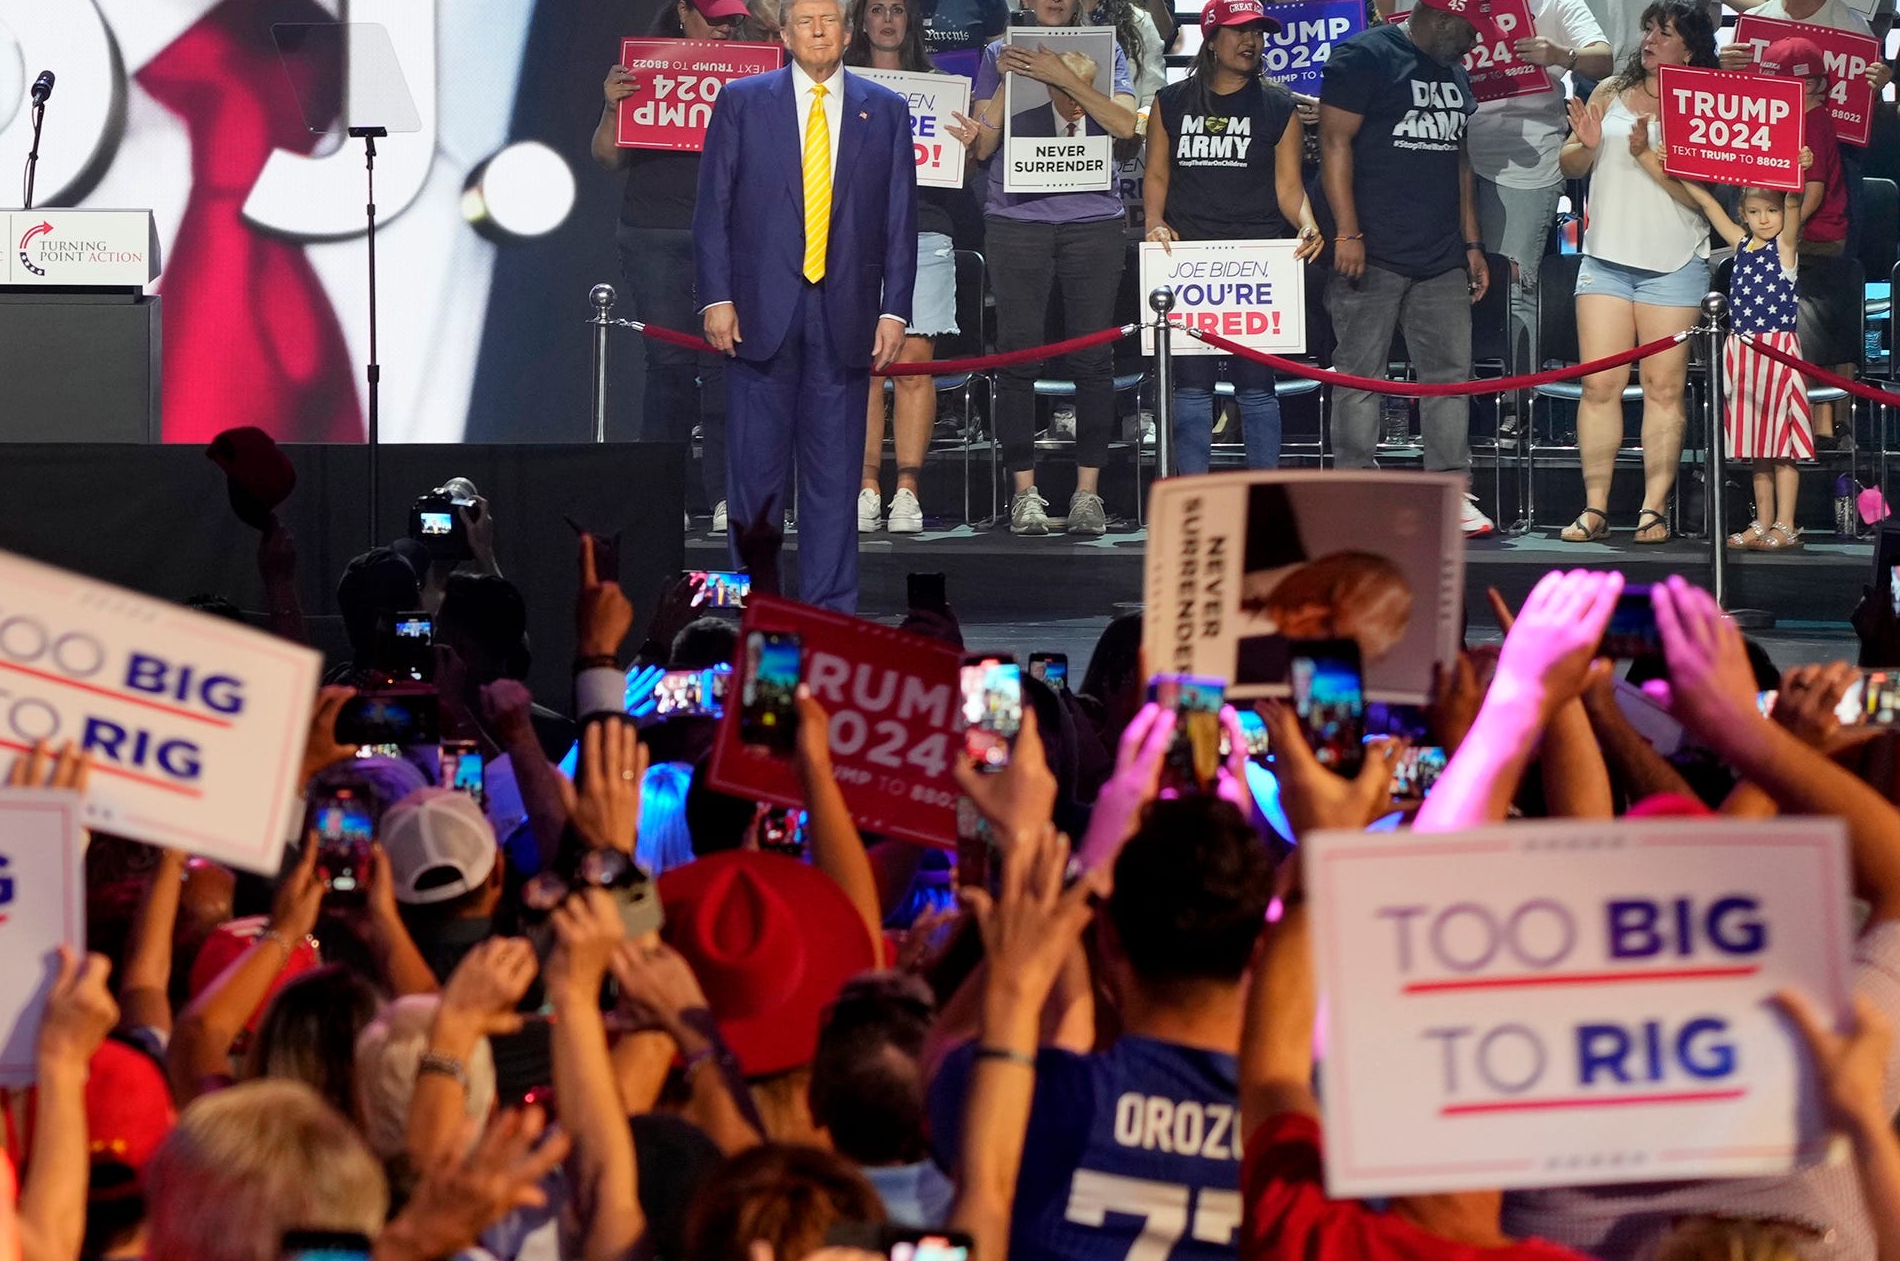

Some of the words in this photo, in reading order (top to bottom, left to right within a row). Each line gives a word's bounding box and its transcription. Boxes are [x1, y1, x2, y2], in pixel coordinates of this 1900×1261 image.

[632, 59, 669, 69] 88022
[673, 61, 688, 70] TO
[692, 62, 733, 73] TRUMP
[1267, 43, 1332, 72] 024
[1749, 38, 1866, 80] TMP
[653, 74, 730, 103] 024
[1265, 73, 1298, 84] RUMP
[1300, 71, 1316, 81] TO
[1410, 78, 1464, 109] DAD
[1672, 89, 1790, 124] TRUMP
[633, 101, 712, 129] UMP
[1180, 115, 1251, 135] MM
[1831, 108, 1861, 123] 88022
[1176, 136, 1252, 159] ARMY
[1689, 118, 1771, 151] 2024
[1036, 145, 1085, 157] NEVER
[1672, 145, 1697, 157] TEXT
[1700, 149, 1736, 162] TRUMP
[1739, 153, 1754, 164] TO
[1757, 157, 1791, 168] 88022
[1014, 160, 1103, 172] SURRENDER
[39, 241, 107, 251] TURNING
[40, 251, 84, 262] POINT
[88, 252, 142, 263] ACTION
[1168, 261, 1208, 278] JOE
[1209, 261, 1269, 278] BIDEN,
[1202, 536, 1226, 638] NEVER
[124, 651, 246, 716] BIG
[804, 651, 965, 732] RUM
[80, 715, 203, 780] RIG
[828, 709, 948, 777] 024
[1375, 897, 1577, 975] TOO
[1605, 895, 1769, 962] BIG
[1421, 1023, 1546, 1096] TO
[1574, 1017, 1739, 1086] RIG
[1114, 1091, 1244, 1160] OROZ
